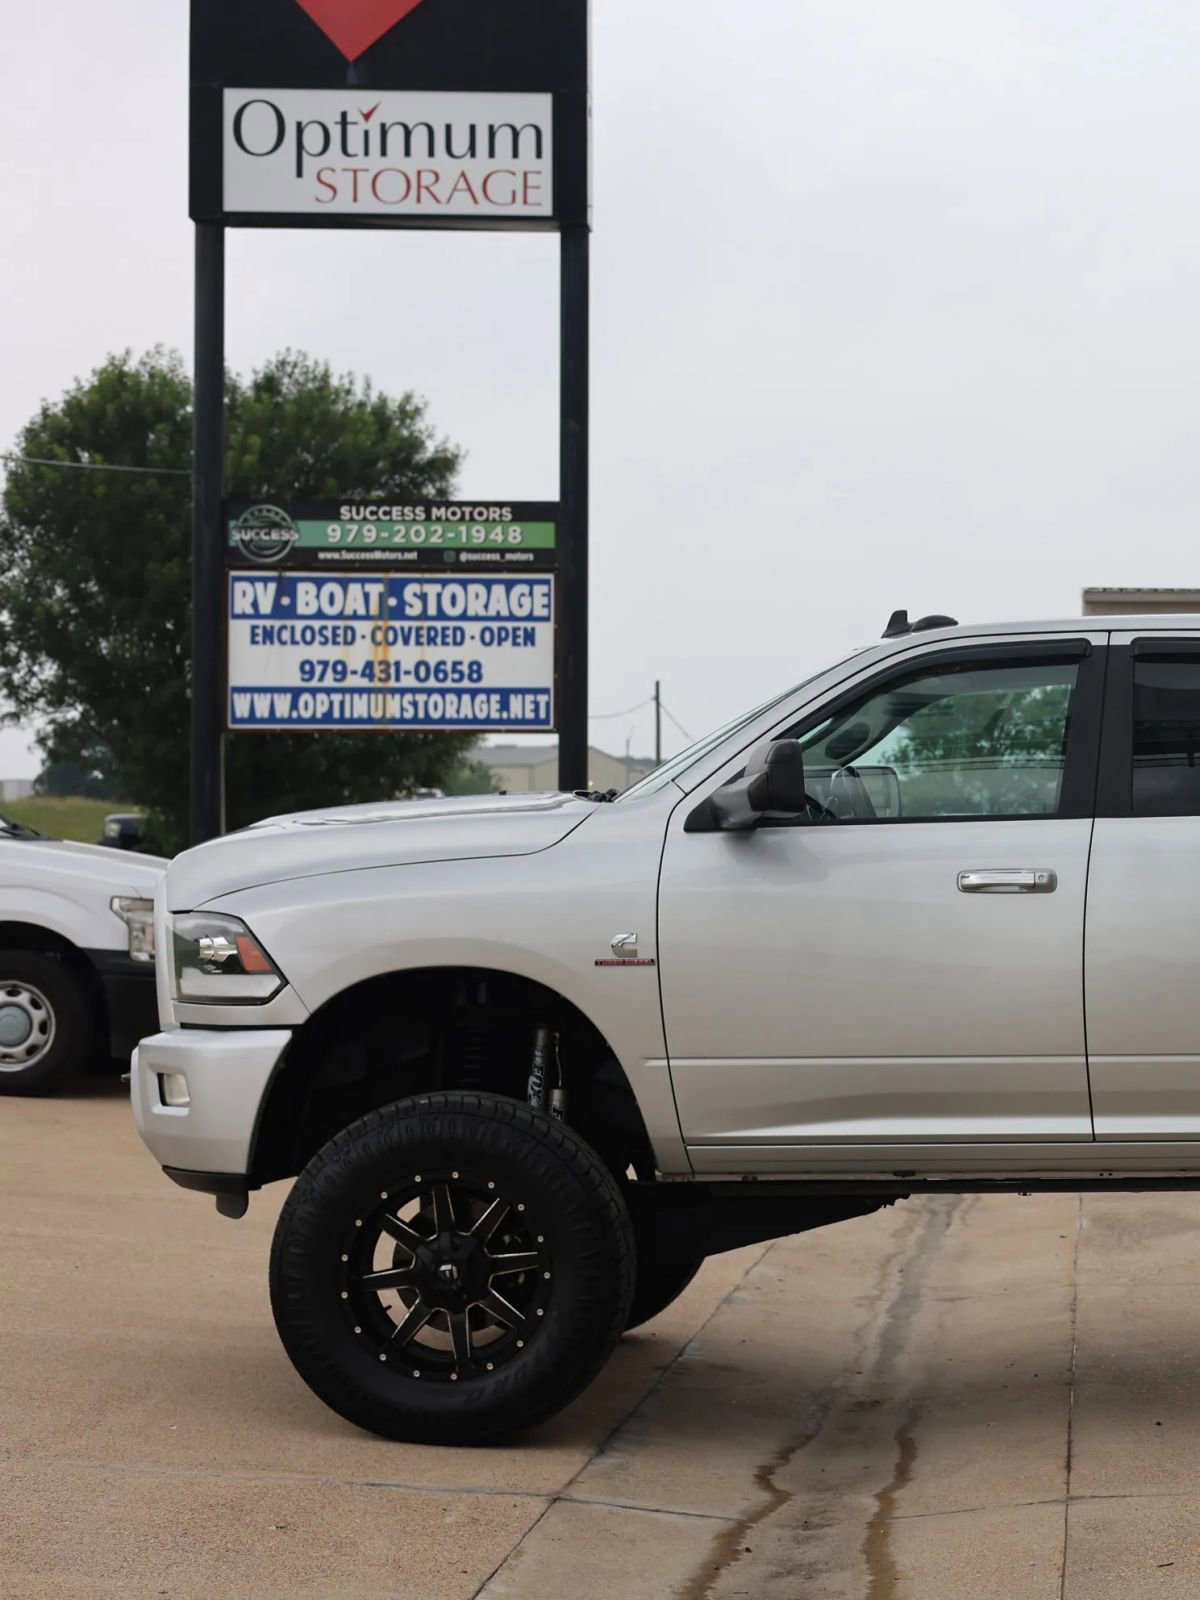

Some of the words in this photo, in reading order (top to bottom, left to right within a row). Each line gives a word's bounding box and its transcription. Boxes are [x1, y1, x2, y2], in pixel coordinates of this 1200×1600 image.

[232, 99, 543, 179] Optimum
[315, 167, 543, 207] STORAGE
[339, 505, 426, 521] SUCCESS
[431, 506, 513, 522] MOTORS
[231, 527, 299, 541] SUCCESS
[326, 524, 523, 544] 979-202-1948
[403, 582, 550, 618] STORAGE
[250, 624, 356, 646] ENCLOSED
[370, 625, 466, 647] COVERED
[479, 625, 537, 648] OPEN
[299, 659, 484, 684] 979-431-0658
[232, 692, 550, 720] WWW.OPTIMUMSTORAGE.NET
